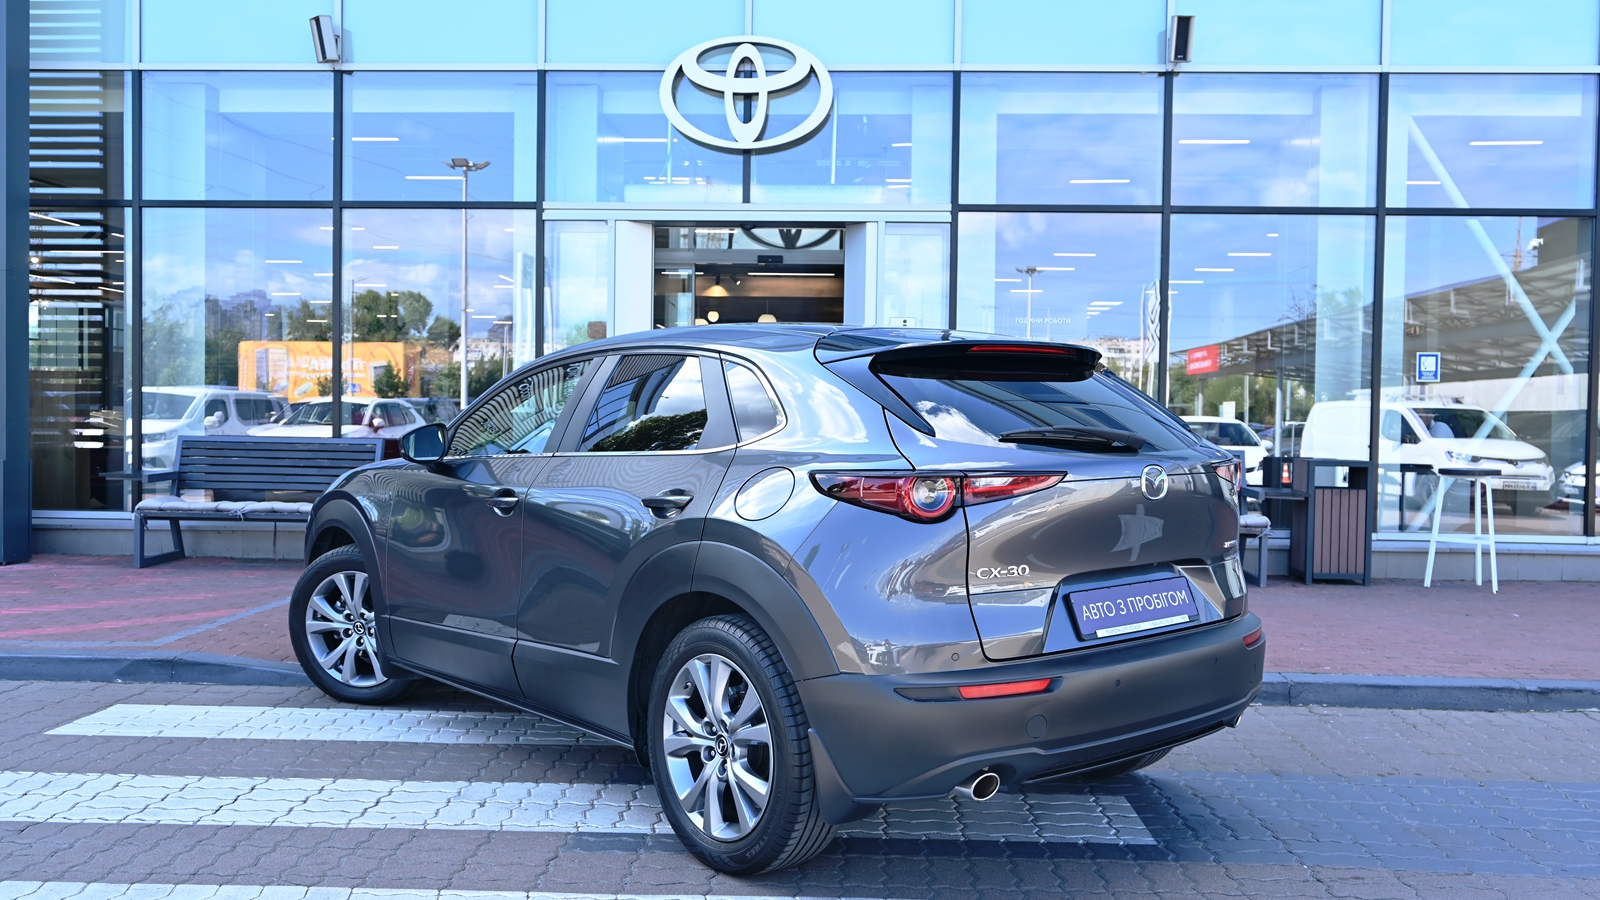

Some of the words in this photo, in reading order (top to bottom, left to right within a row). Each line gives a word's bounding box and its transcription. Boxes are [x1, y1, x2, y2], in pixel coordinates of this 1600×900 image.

[976, 564, 1030, 579] CX-30
[1082, 601, 1116, 621] АВТО
[1126, 589, 1189, 613] ПРОБІГОМ
[745, 834, 769, 860] TYRES
